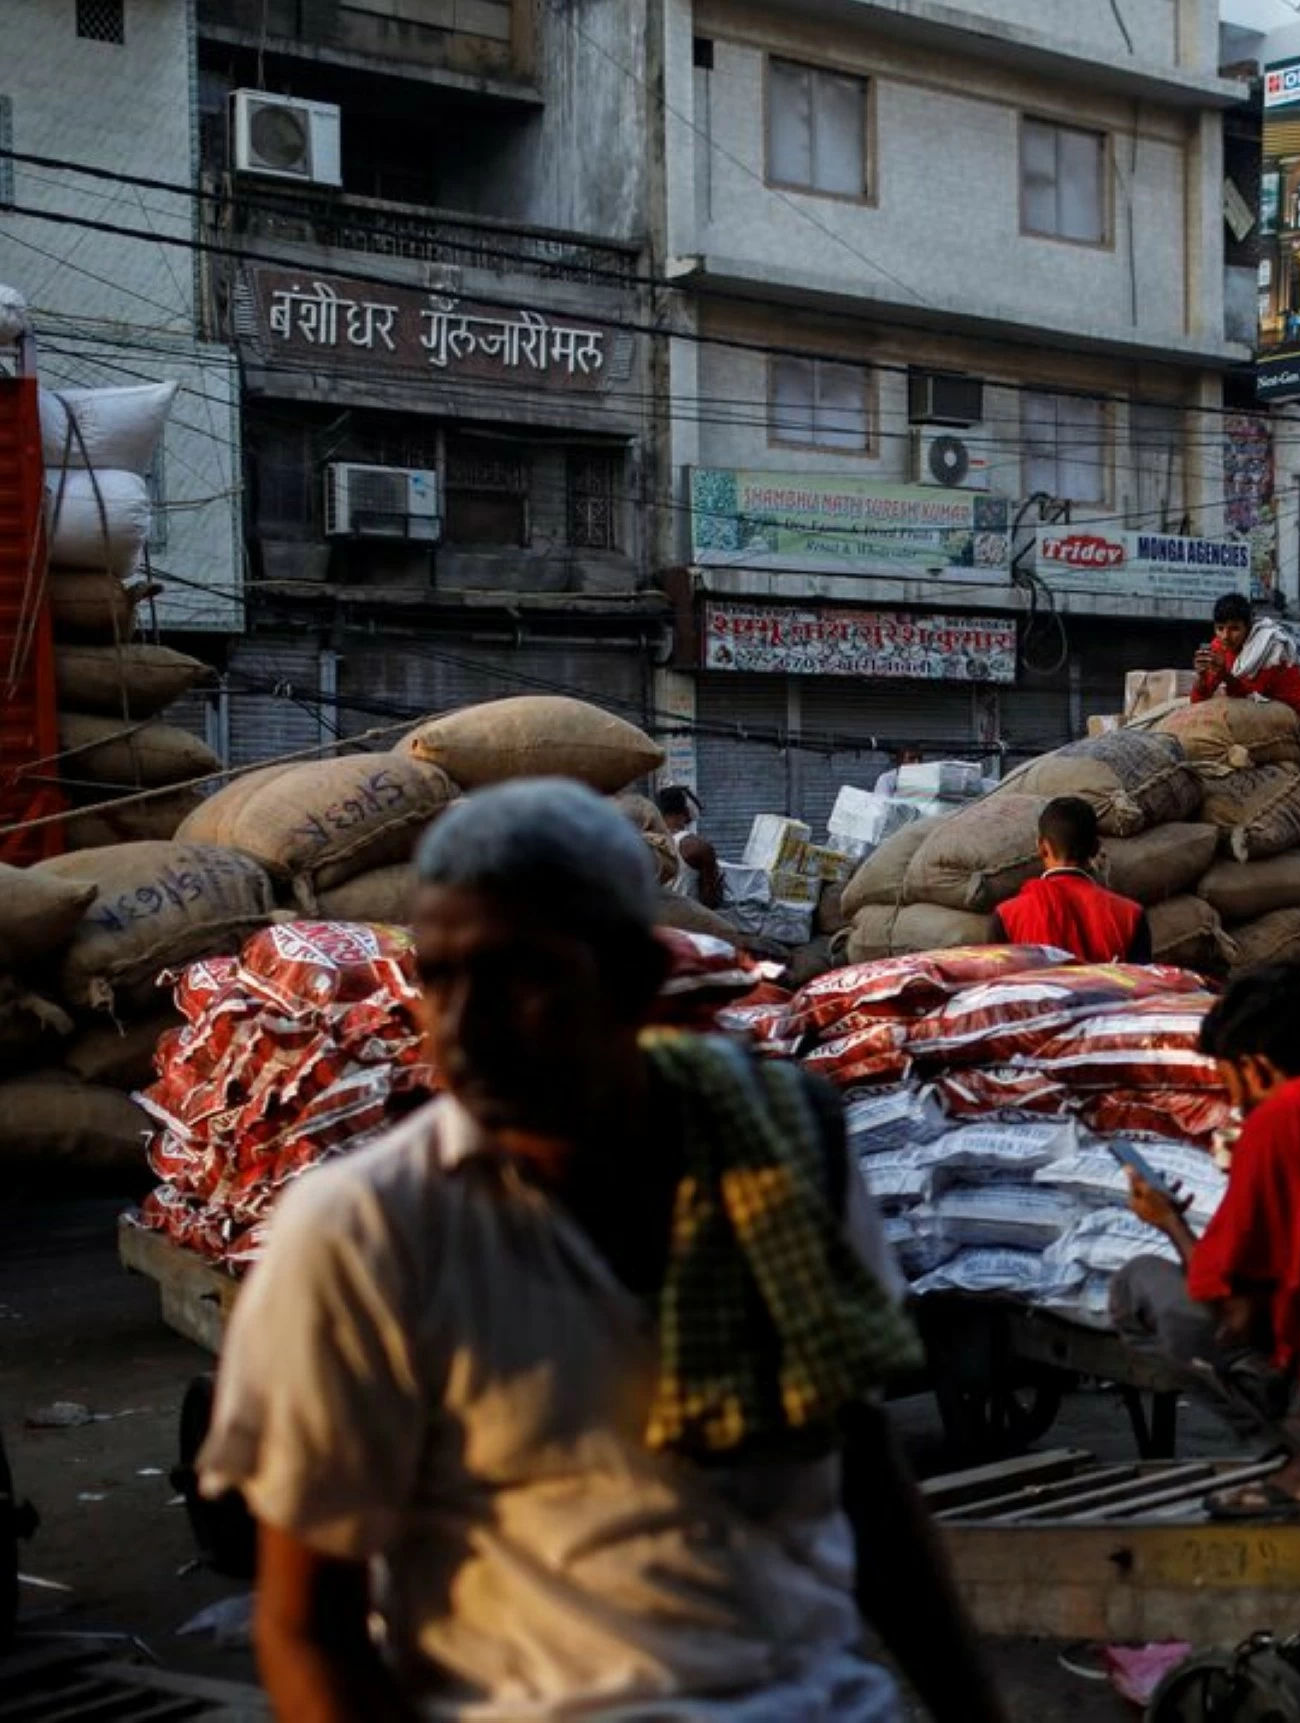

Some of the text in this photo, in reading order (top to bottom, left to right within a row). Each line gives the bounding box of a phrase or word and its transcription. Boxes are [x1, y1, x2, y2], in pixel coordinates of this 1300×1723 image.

[1044, 539, 1122, 564] Tridev
[1137, 537, 1249, 568] MONGA AGENCIES
